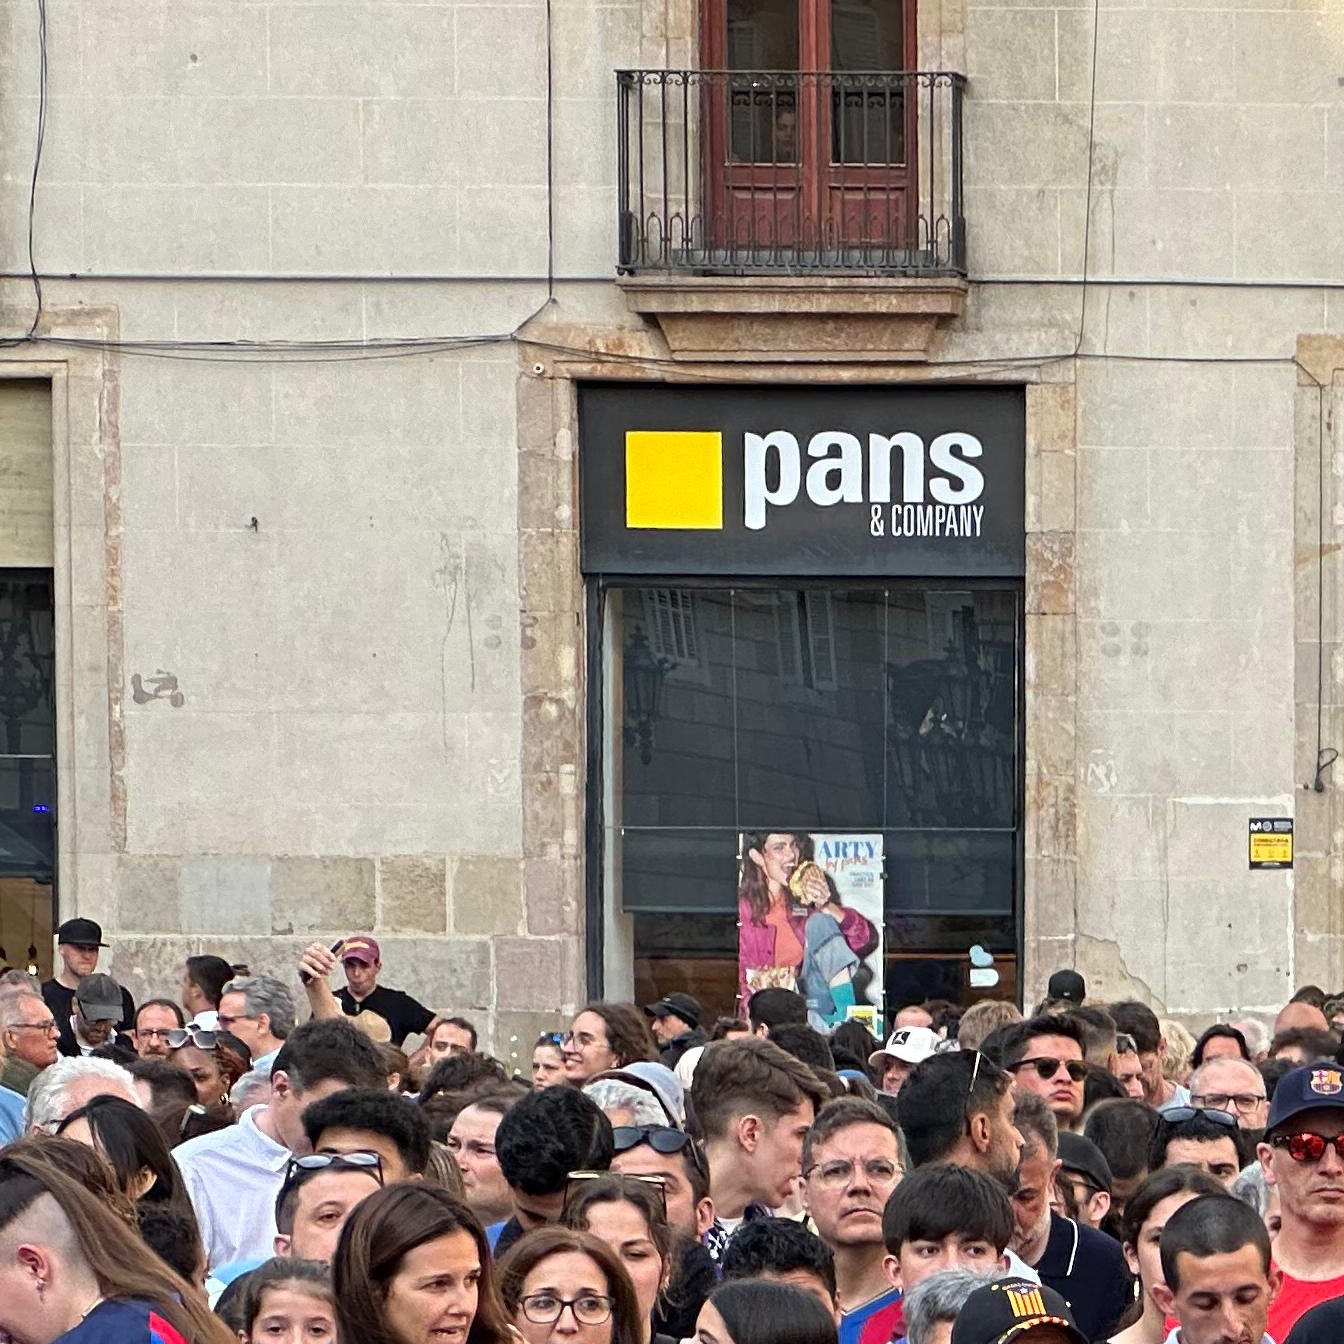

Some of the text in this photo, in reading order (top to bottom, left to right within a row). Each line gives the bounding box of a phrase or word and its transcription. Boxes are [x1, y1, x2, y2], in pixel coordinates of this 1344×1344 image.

[743, 431, 985, 530] pans
[870, 504, 985, 537] & COMPANY
[819, 840, 879, 858] ARTY
